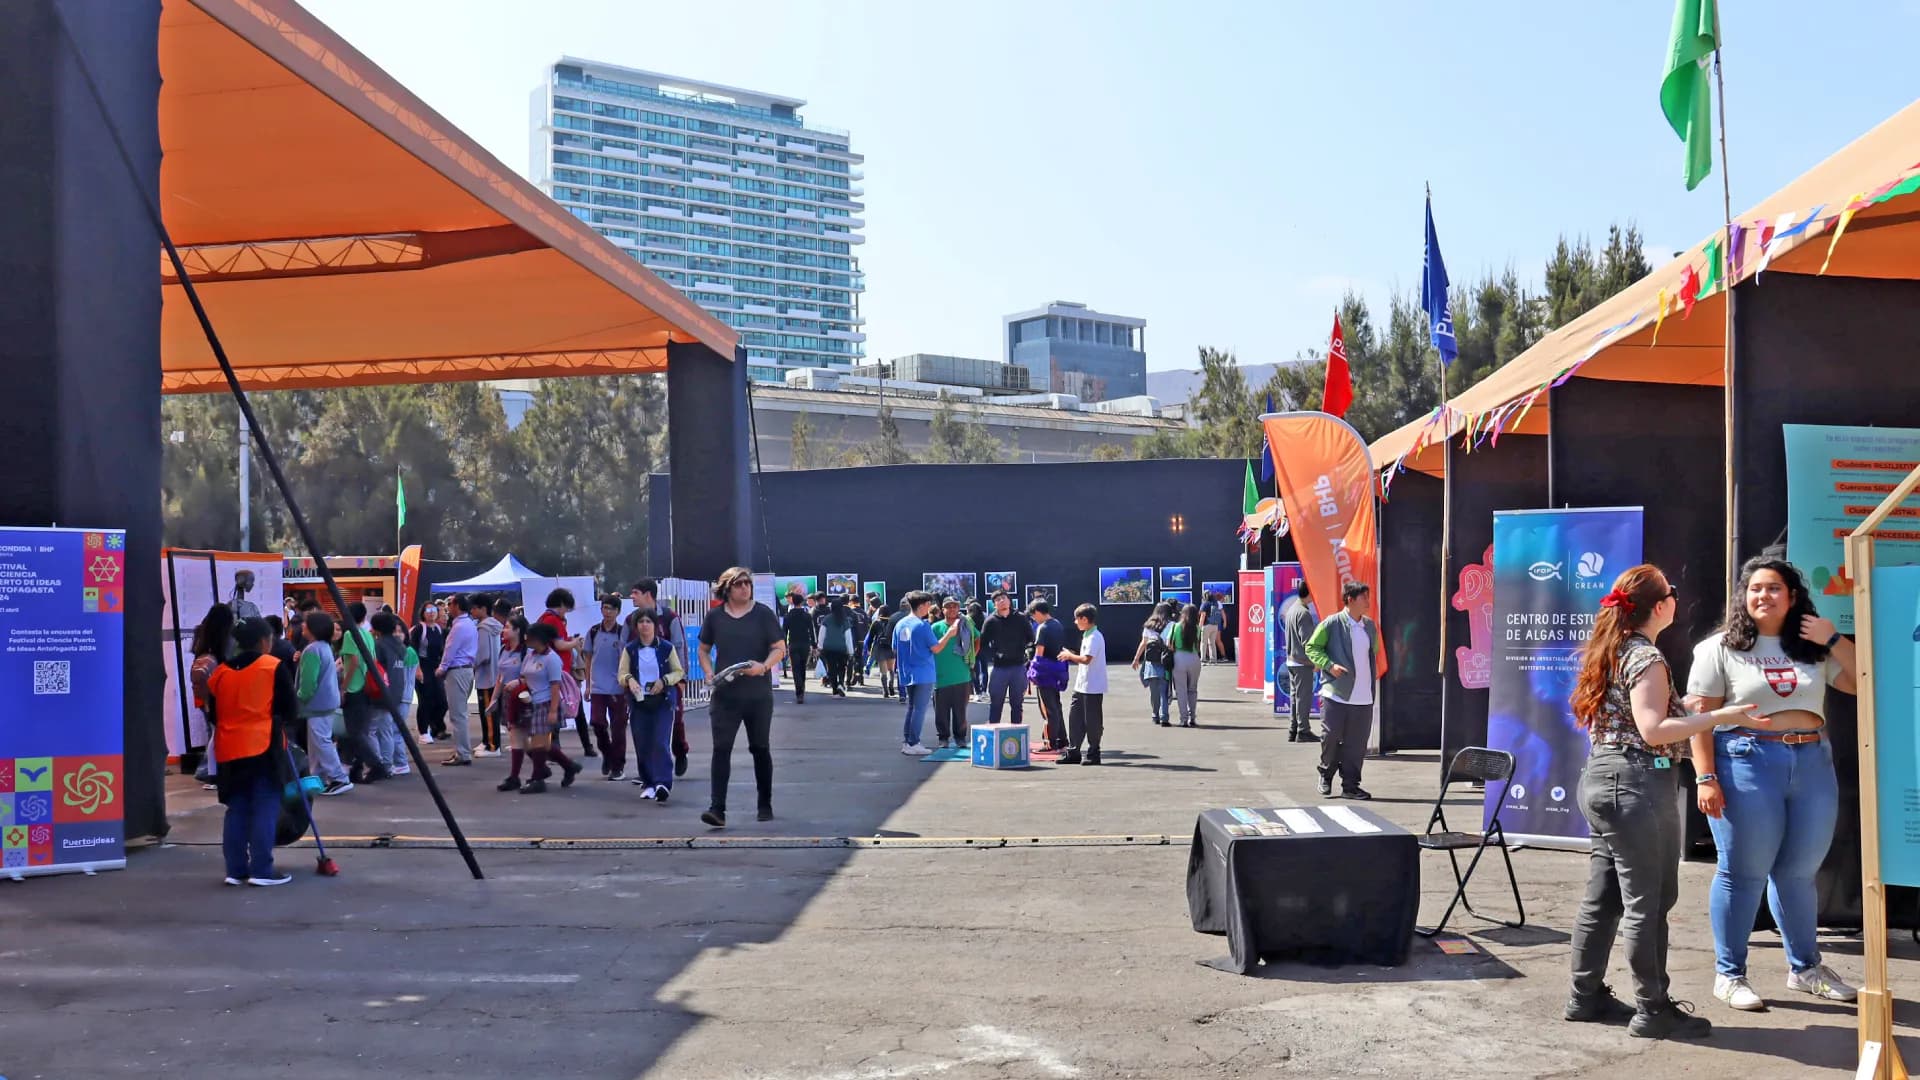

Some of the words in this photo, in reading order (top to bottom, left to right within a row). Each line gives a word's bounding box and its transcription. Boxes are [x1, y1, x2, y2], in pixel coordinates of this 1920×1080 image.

[1575, 582, 1605, 590] CREAN
[1506, 613, 1549, 625] CENTRO
[1552, 613, 1567, 625] DE
[1506, 629, 1521, 641] DE
[1525, 629, 1564, 641] ALGAS
